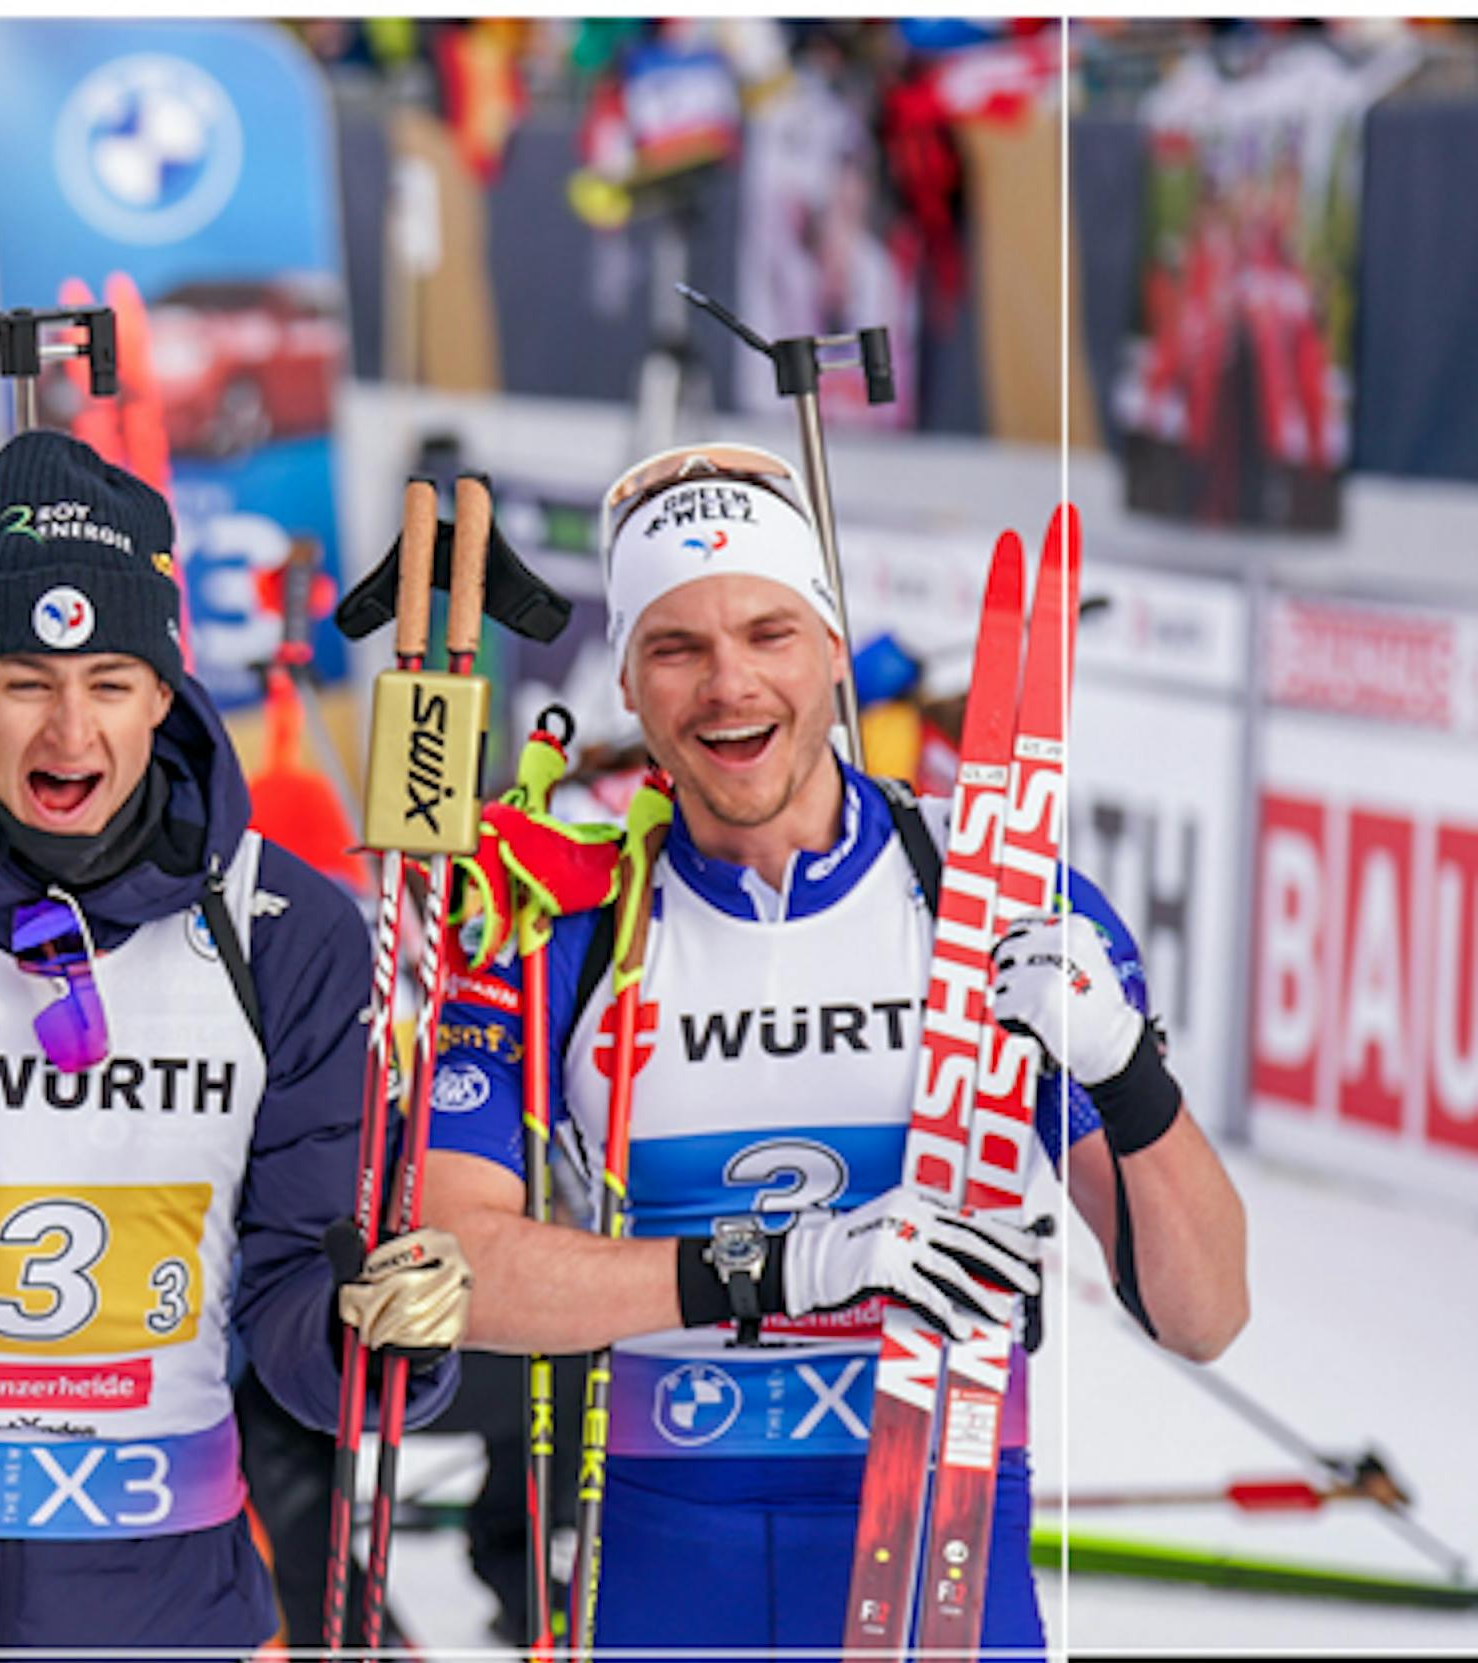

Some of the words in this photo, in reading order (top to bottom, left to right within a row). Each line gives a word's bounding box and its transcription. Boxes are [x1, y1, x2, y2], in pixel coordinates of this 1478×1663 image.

[679, 999, 926, 1064] WÜRT
[874, 797, 1007, 1411] MDSHUS
[145, 1258, 191, 1337] 3
[530, 1361, 553, 1455] EKI
[27, 1444, 174, 1528] X3
